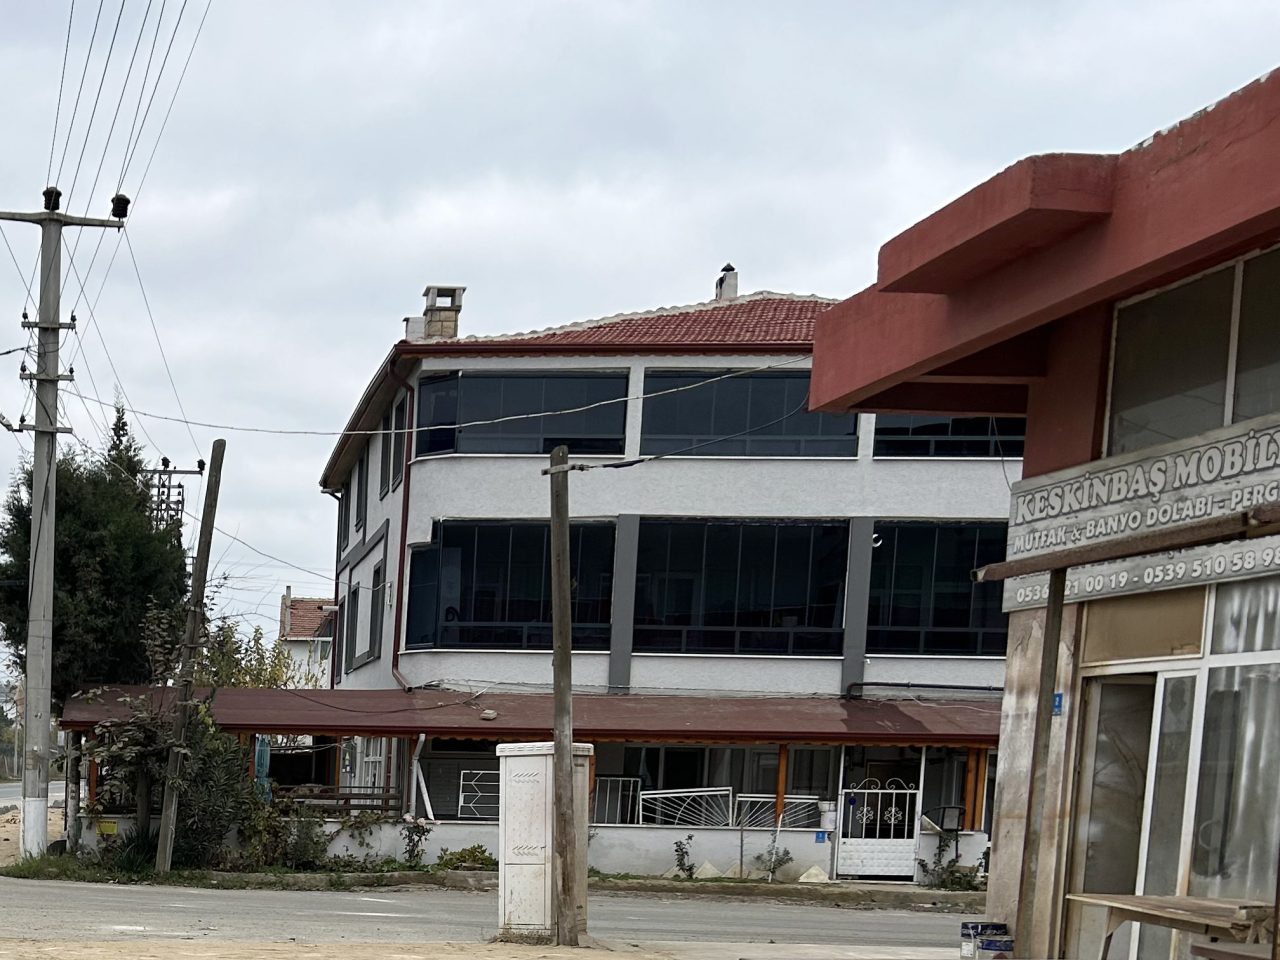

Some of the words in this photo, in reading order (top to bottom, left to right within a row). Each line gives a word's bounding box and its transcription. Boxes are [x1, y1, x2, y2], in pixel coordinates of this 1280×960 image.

[1015, 460, 1167, 524] KESKİNBAŞ
[1014, 526, 1067, 553] MUTFAK
[1086, 510, 1141, 539] BANYO
[1146, 496, 1213, 527] DOLABI
[1085, 575, 1104, 593] 00
[1109, 571, 1128, 590] 19
[1143, 562, 1186, 584] 0539
[1191, 556, 1226, 577] 510
[1231, 550, 1256, 572] 58
